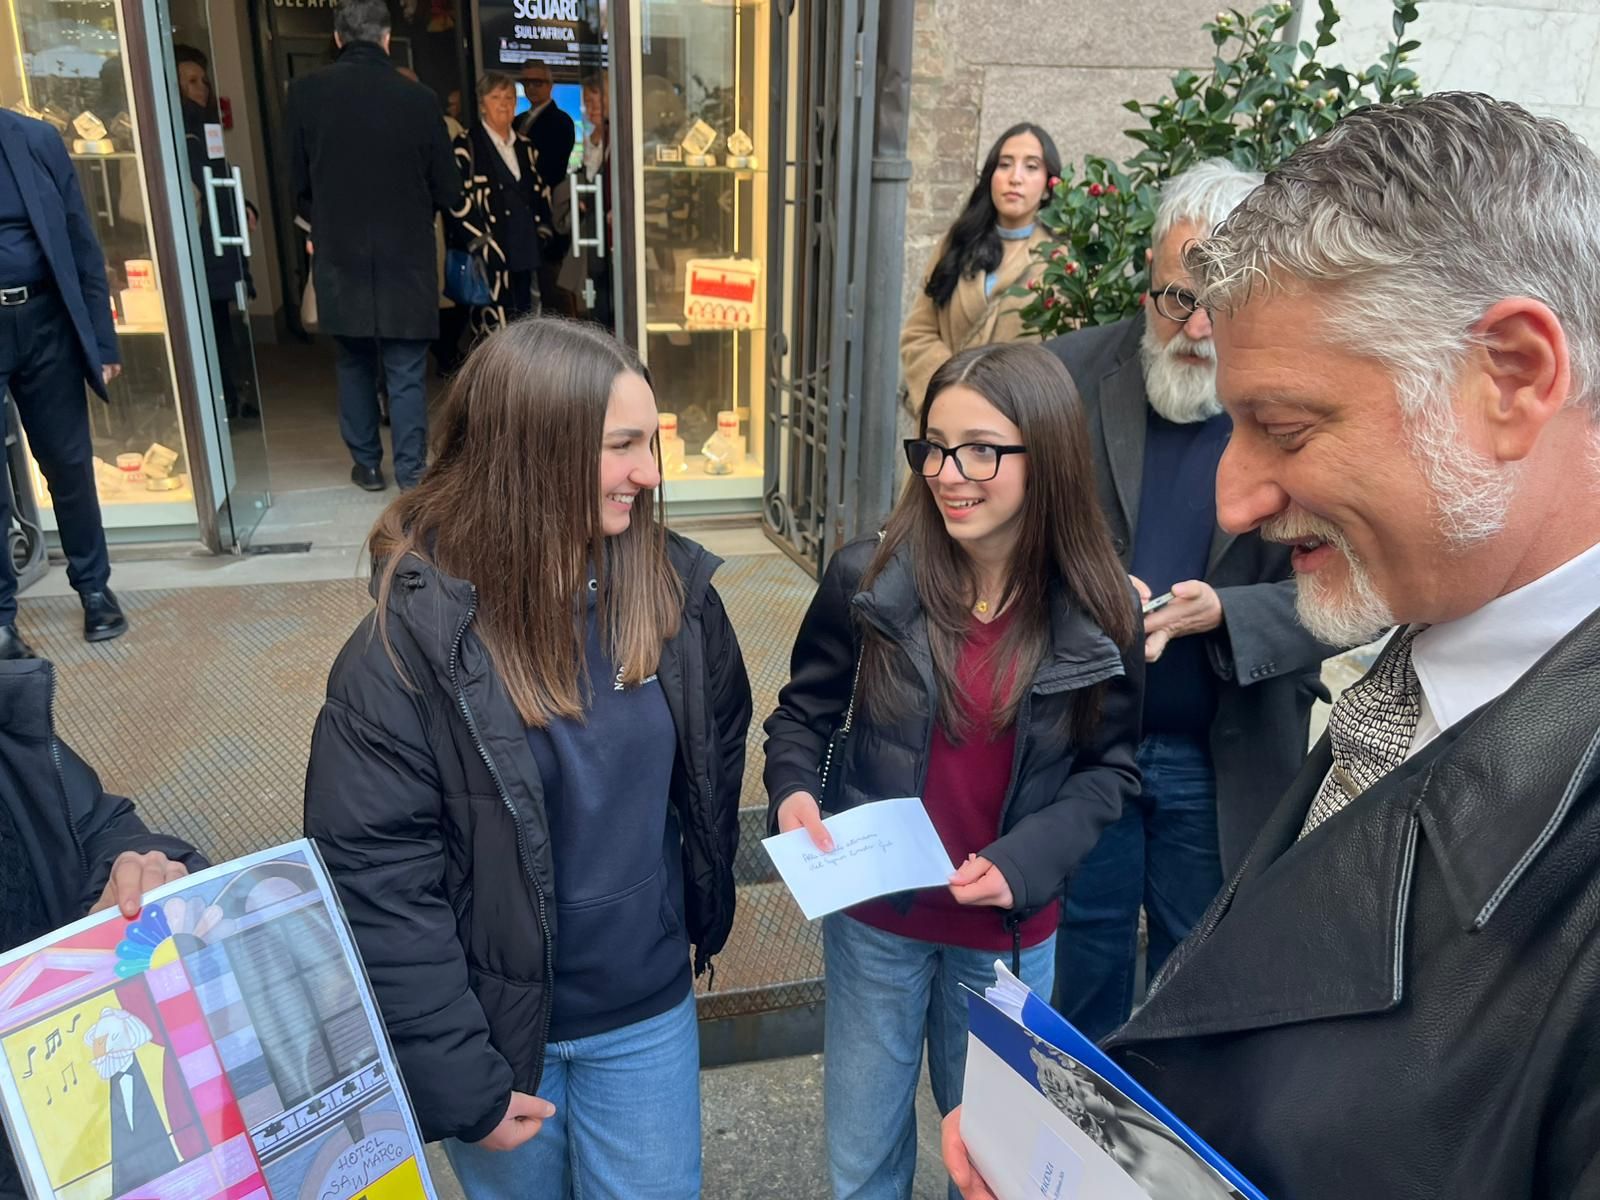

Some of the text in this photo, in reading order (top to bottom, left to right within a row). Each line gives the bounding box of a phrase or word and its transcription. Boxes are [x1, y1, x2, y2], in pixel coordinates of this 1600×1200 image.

[514, 24, 576, 41] SULL'AFRICA
[337, 1137, 385, 1171] HOTEL
[363, 1142, 404, 1186] MARCO
